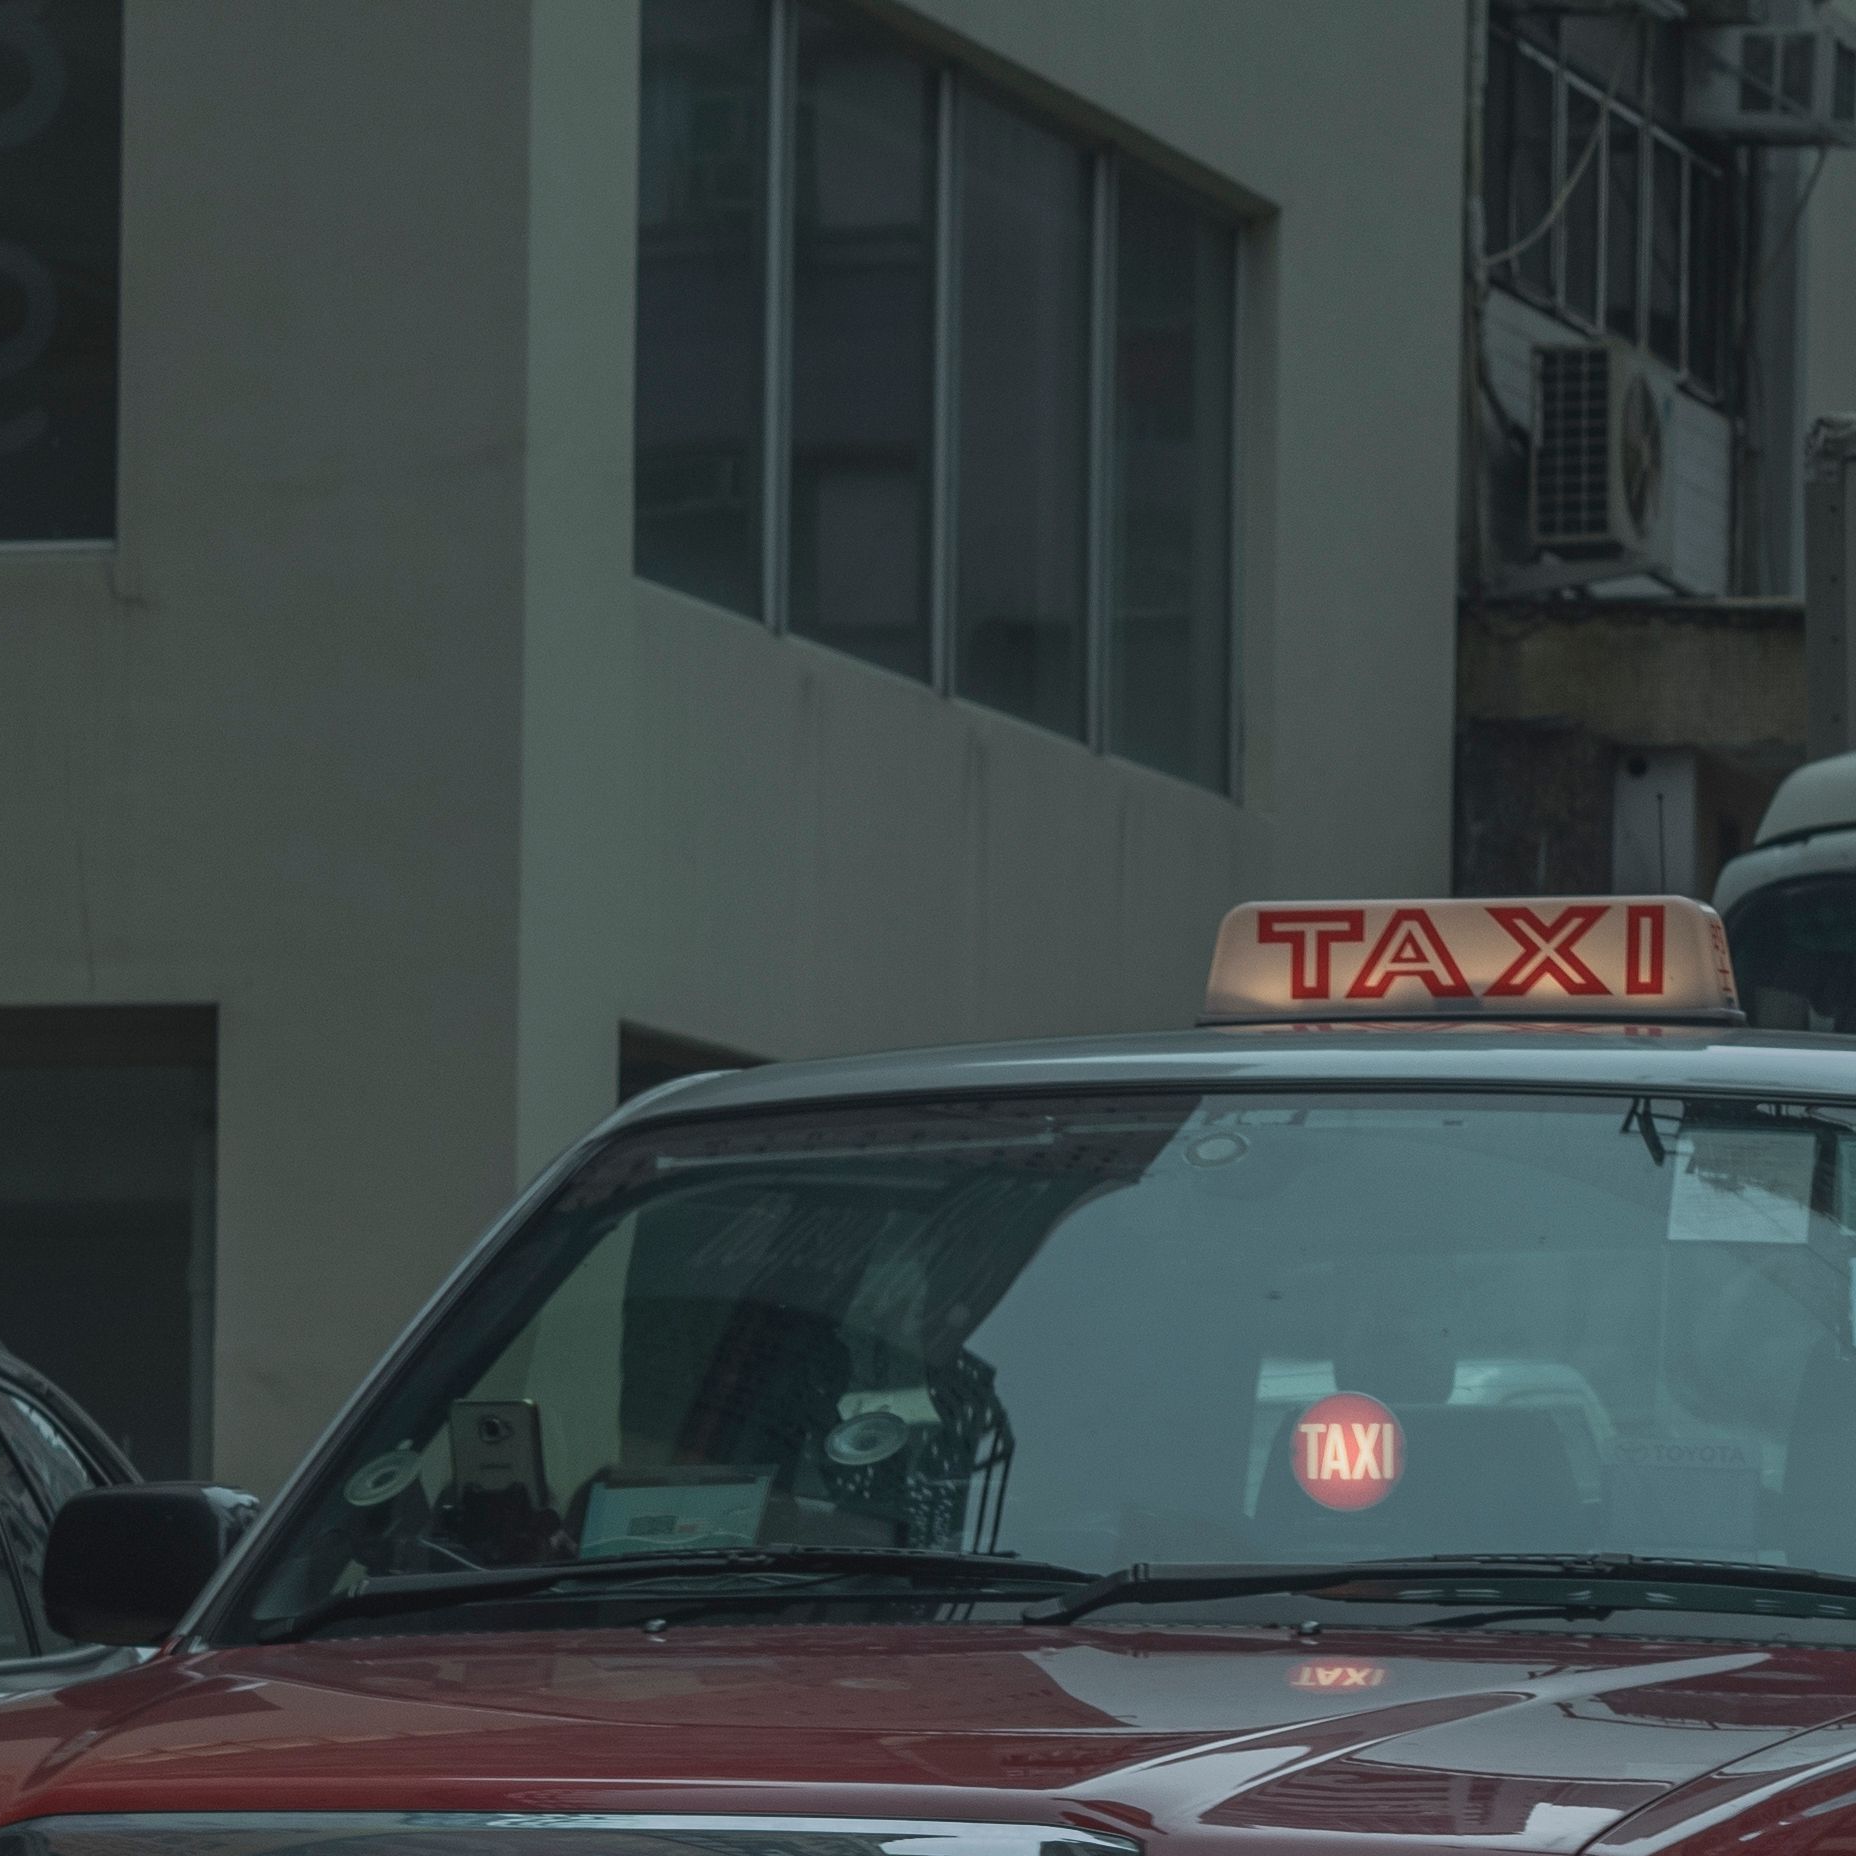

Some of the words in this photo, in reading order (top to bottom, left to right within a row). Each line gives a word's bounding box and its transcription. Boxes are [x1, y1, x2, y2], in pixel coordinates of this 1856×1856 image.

[1257, 904, 1665, 1000] TAXI
[1297, 1421, 1395, 1481] TAXI
[1652, 1443, 1746, 1465] TOYOTA
